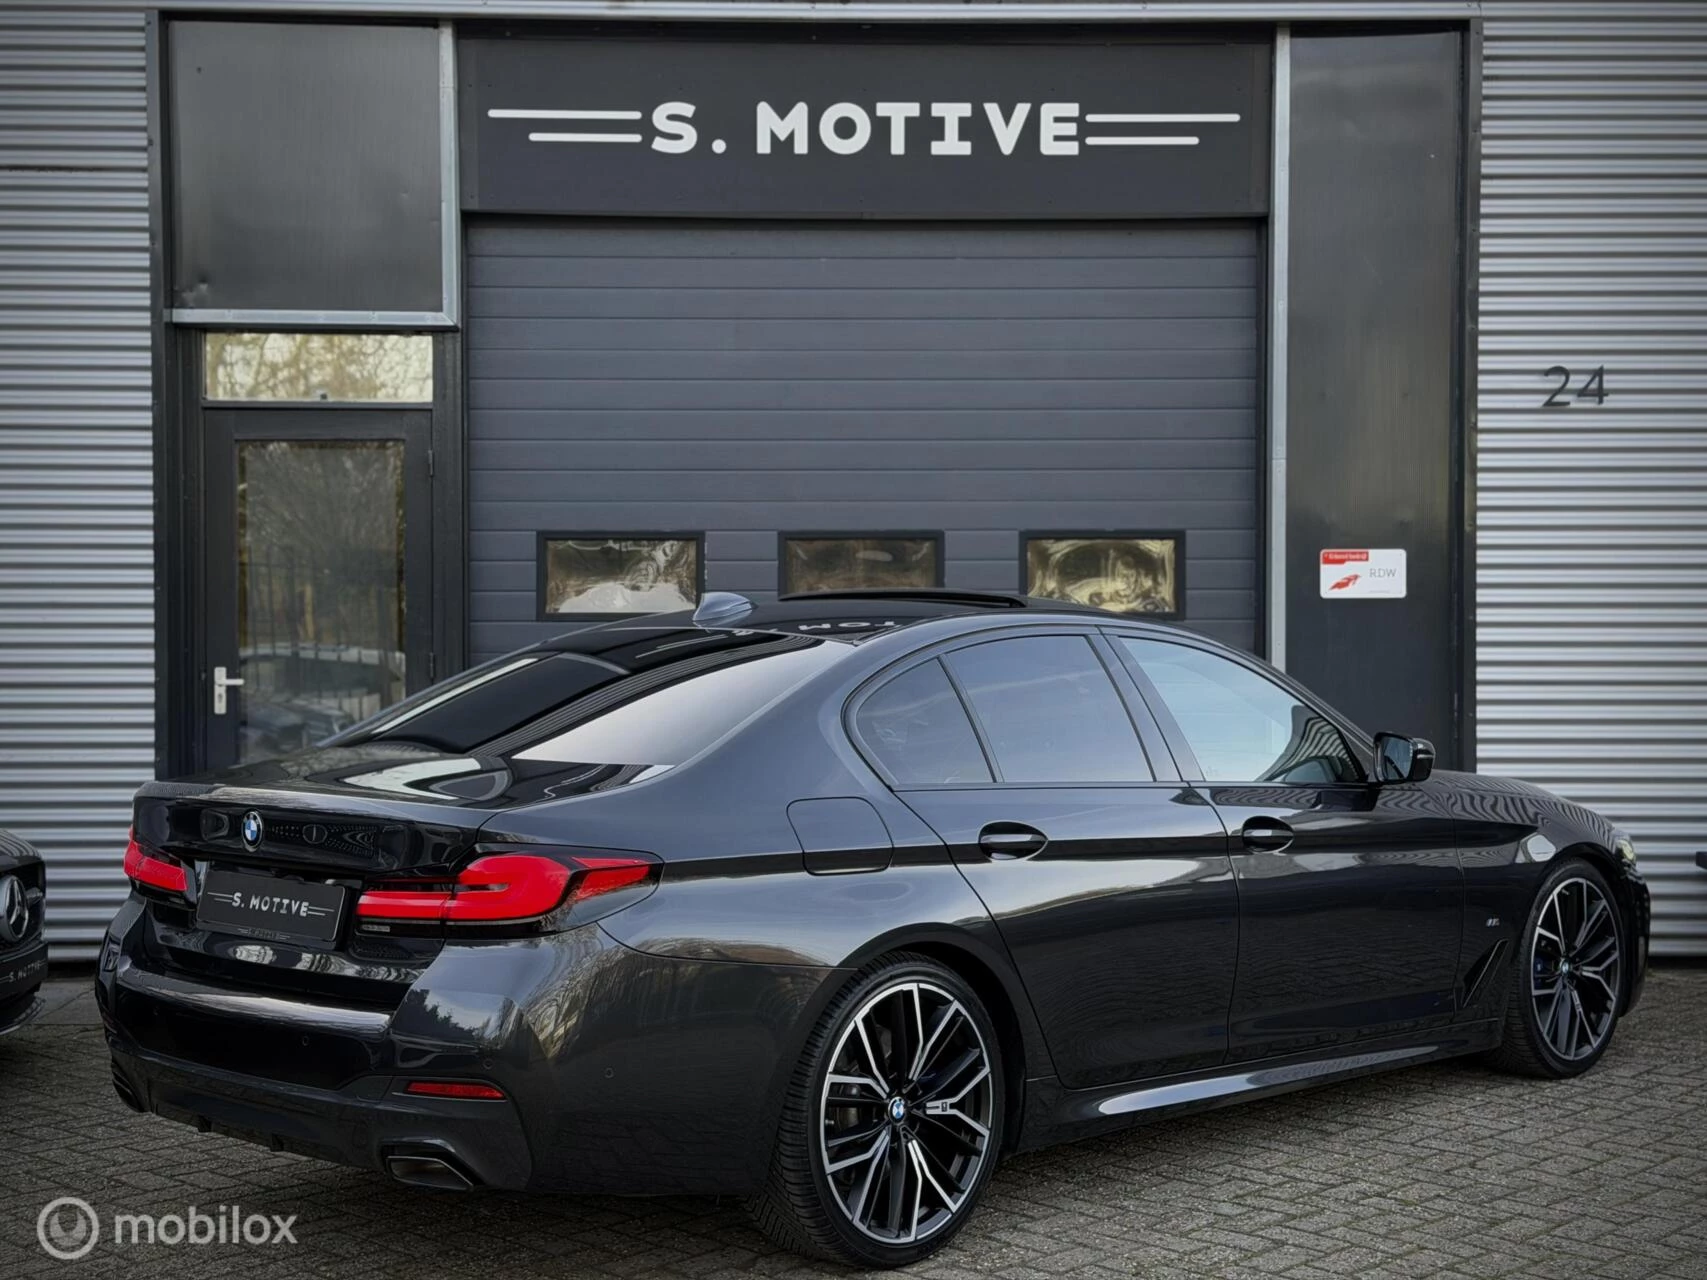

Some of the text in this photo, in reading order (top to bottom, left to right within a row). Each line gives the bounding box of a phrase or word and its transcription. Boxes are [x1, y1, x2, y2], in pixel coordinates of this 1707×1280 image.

[651, 100, 1080, 156] S. MOTIVE
[1542, 364, 1609, 407] 24
[1369, 568, 1397, 578] RDW
[231, 892, 310, 917] S. MOTIVE
